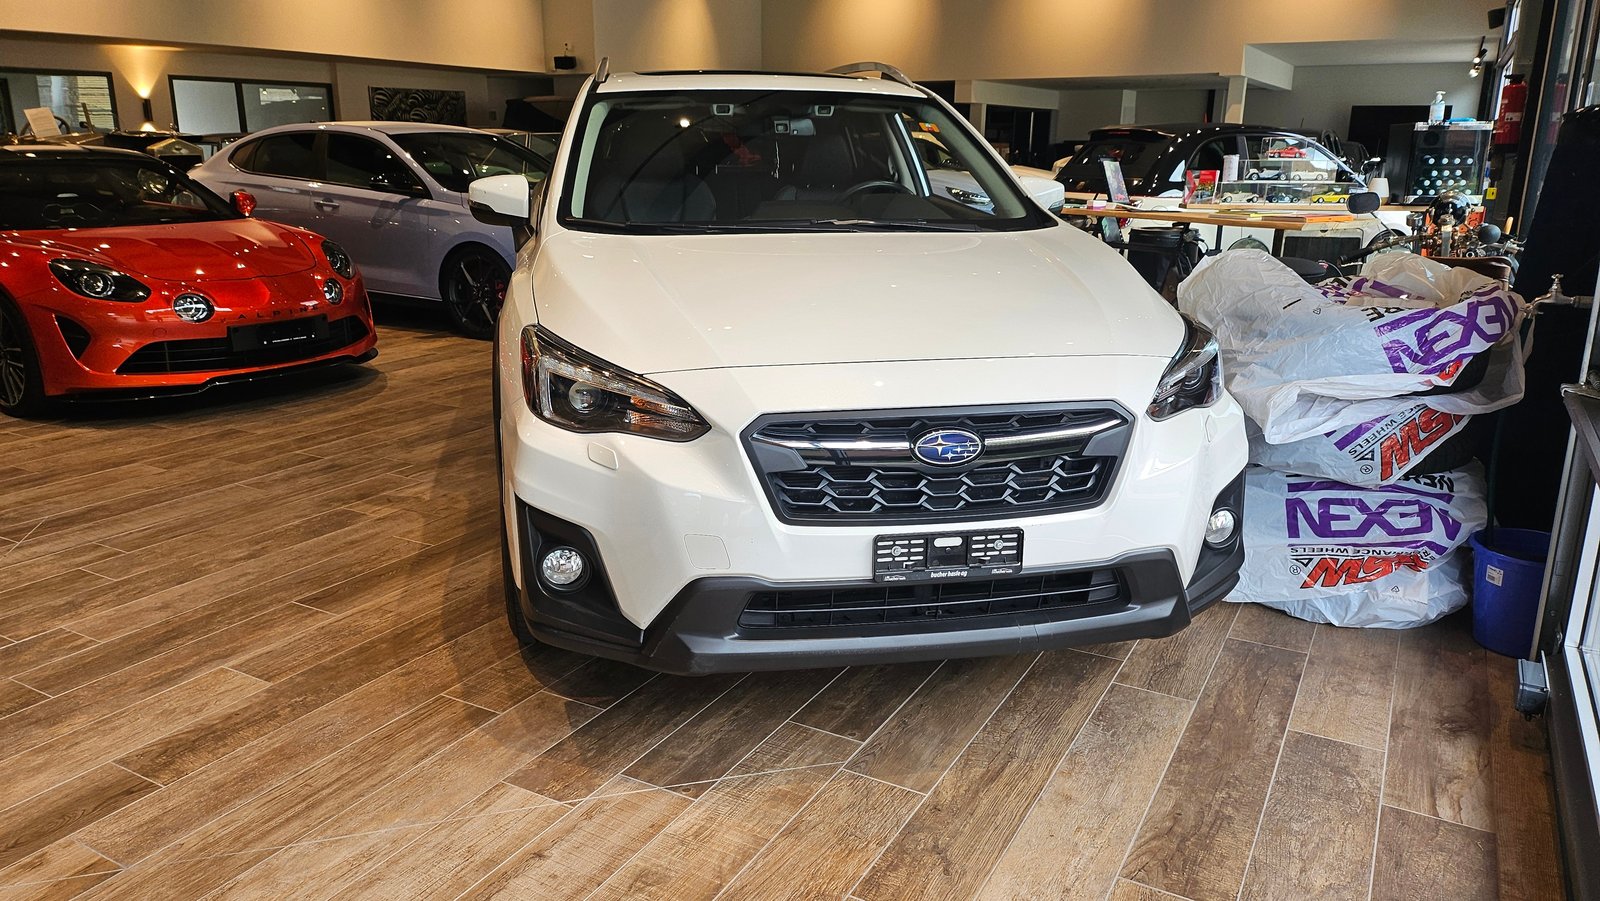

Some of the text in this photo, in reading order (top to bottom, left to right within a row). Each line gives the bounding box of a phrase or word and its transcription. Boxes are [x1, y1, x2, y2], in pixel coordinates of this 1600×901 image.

[238, 304, 319, 320] ALPINE
[1382, 295, 1518, 373] NEXEN
[1348, 418, 1398, 456] WHEELS
[1381, 408, 1465, 482] SW
[1286, 498, 1462, 541] NEXEN
[1290, 547, 1349, 555] WHEELS
